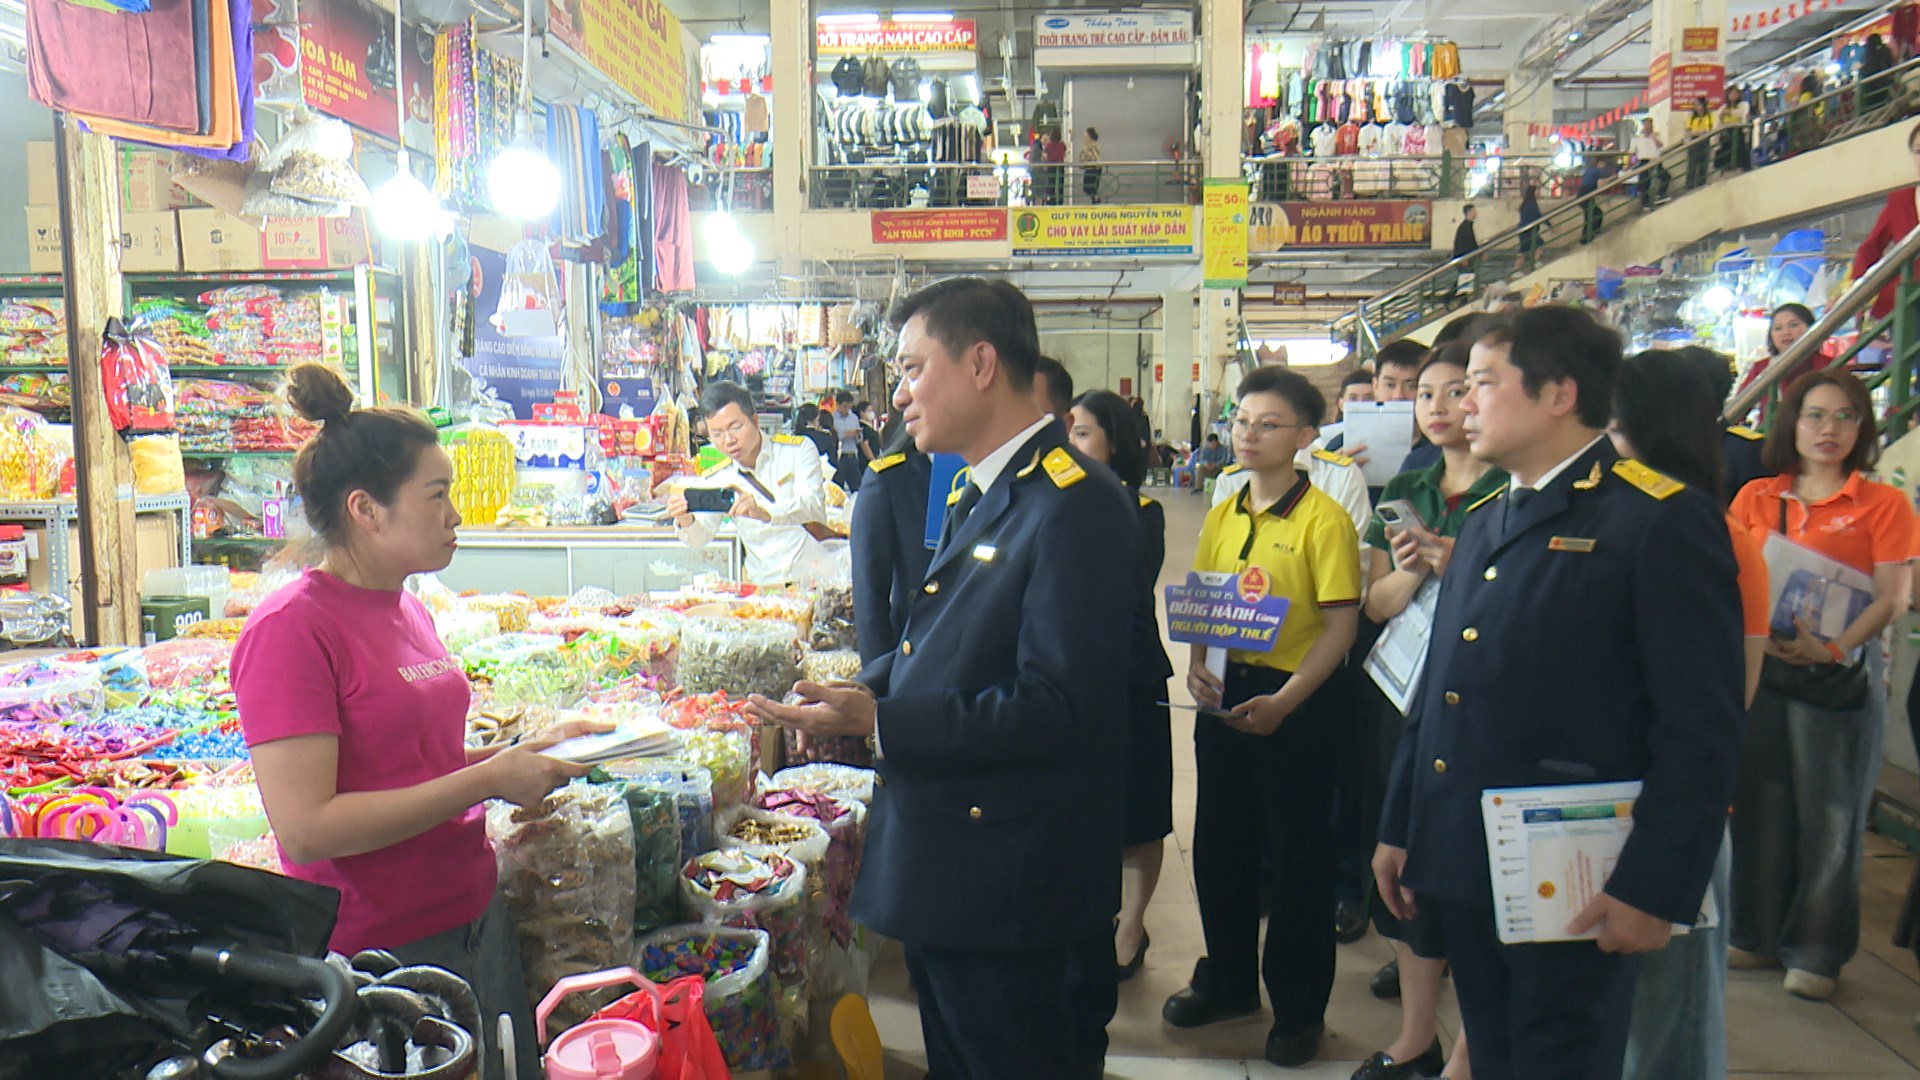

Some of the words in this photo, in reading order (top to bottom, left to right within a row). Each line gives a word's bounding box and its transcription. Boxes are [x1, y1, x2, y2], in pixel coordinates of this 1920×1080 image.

[840, 32, 884, 47] TRANG
[886, 31, 914, 46] NAM
[915, 30, 943, 45] CAO
[945, 27, 972, 44] CẤP
[1061, 33, 1088, 46] TRANG
[1107, 32, 1125, 44] CAO
[1344, 206, 1377, 217] HÀNG
[1047, 226, 1067, 238] CHO
[1070, 225, 1090, 237] VAY
[1301, 221, 1323, 243] ÁO
[1369, 223, 1424, 242] TRANG
[1168, 598, 1209, 617] ĐỒNG
[1210, 603, 1256, 621] HÀNH
[1210, 623, 1238, 638] NỘP
[1239, 627, 1276, 642] THUẾ
